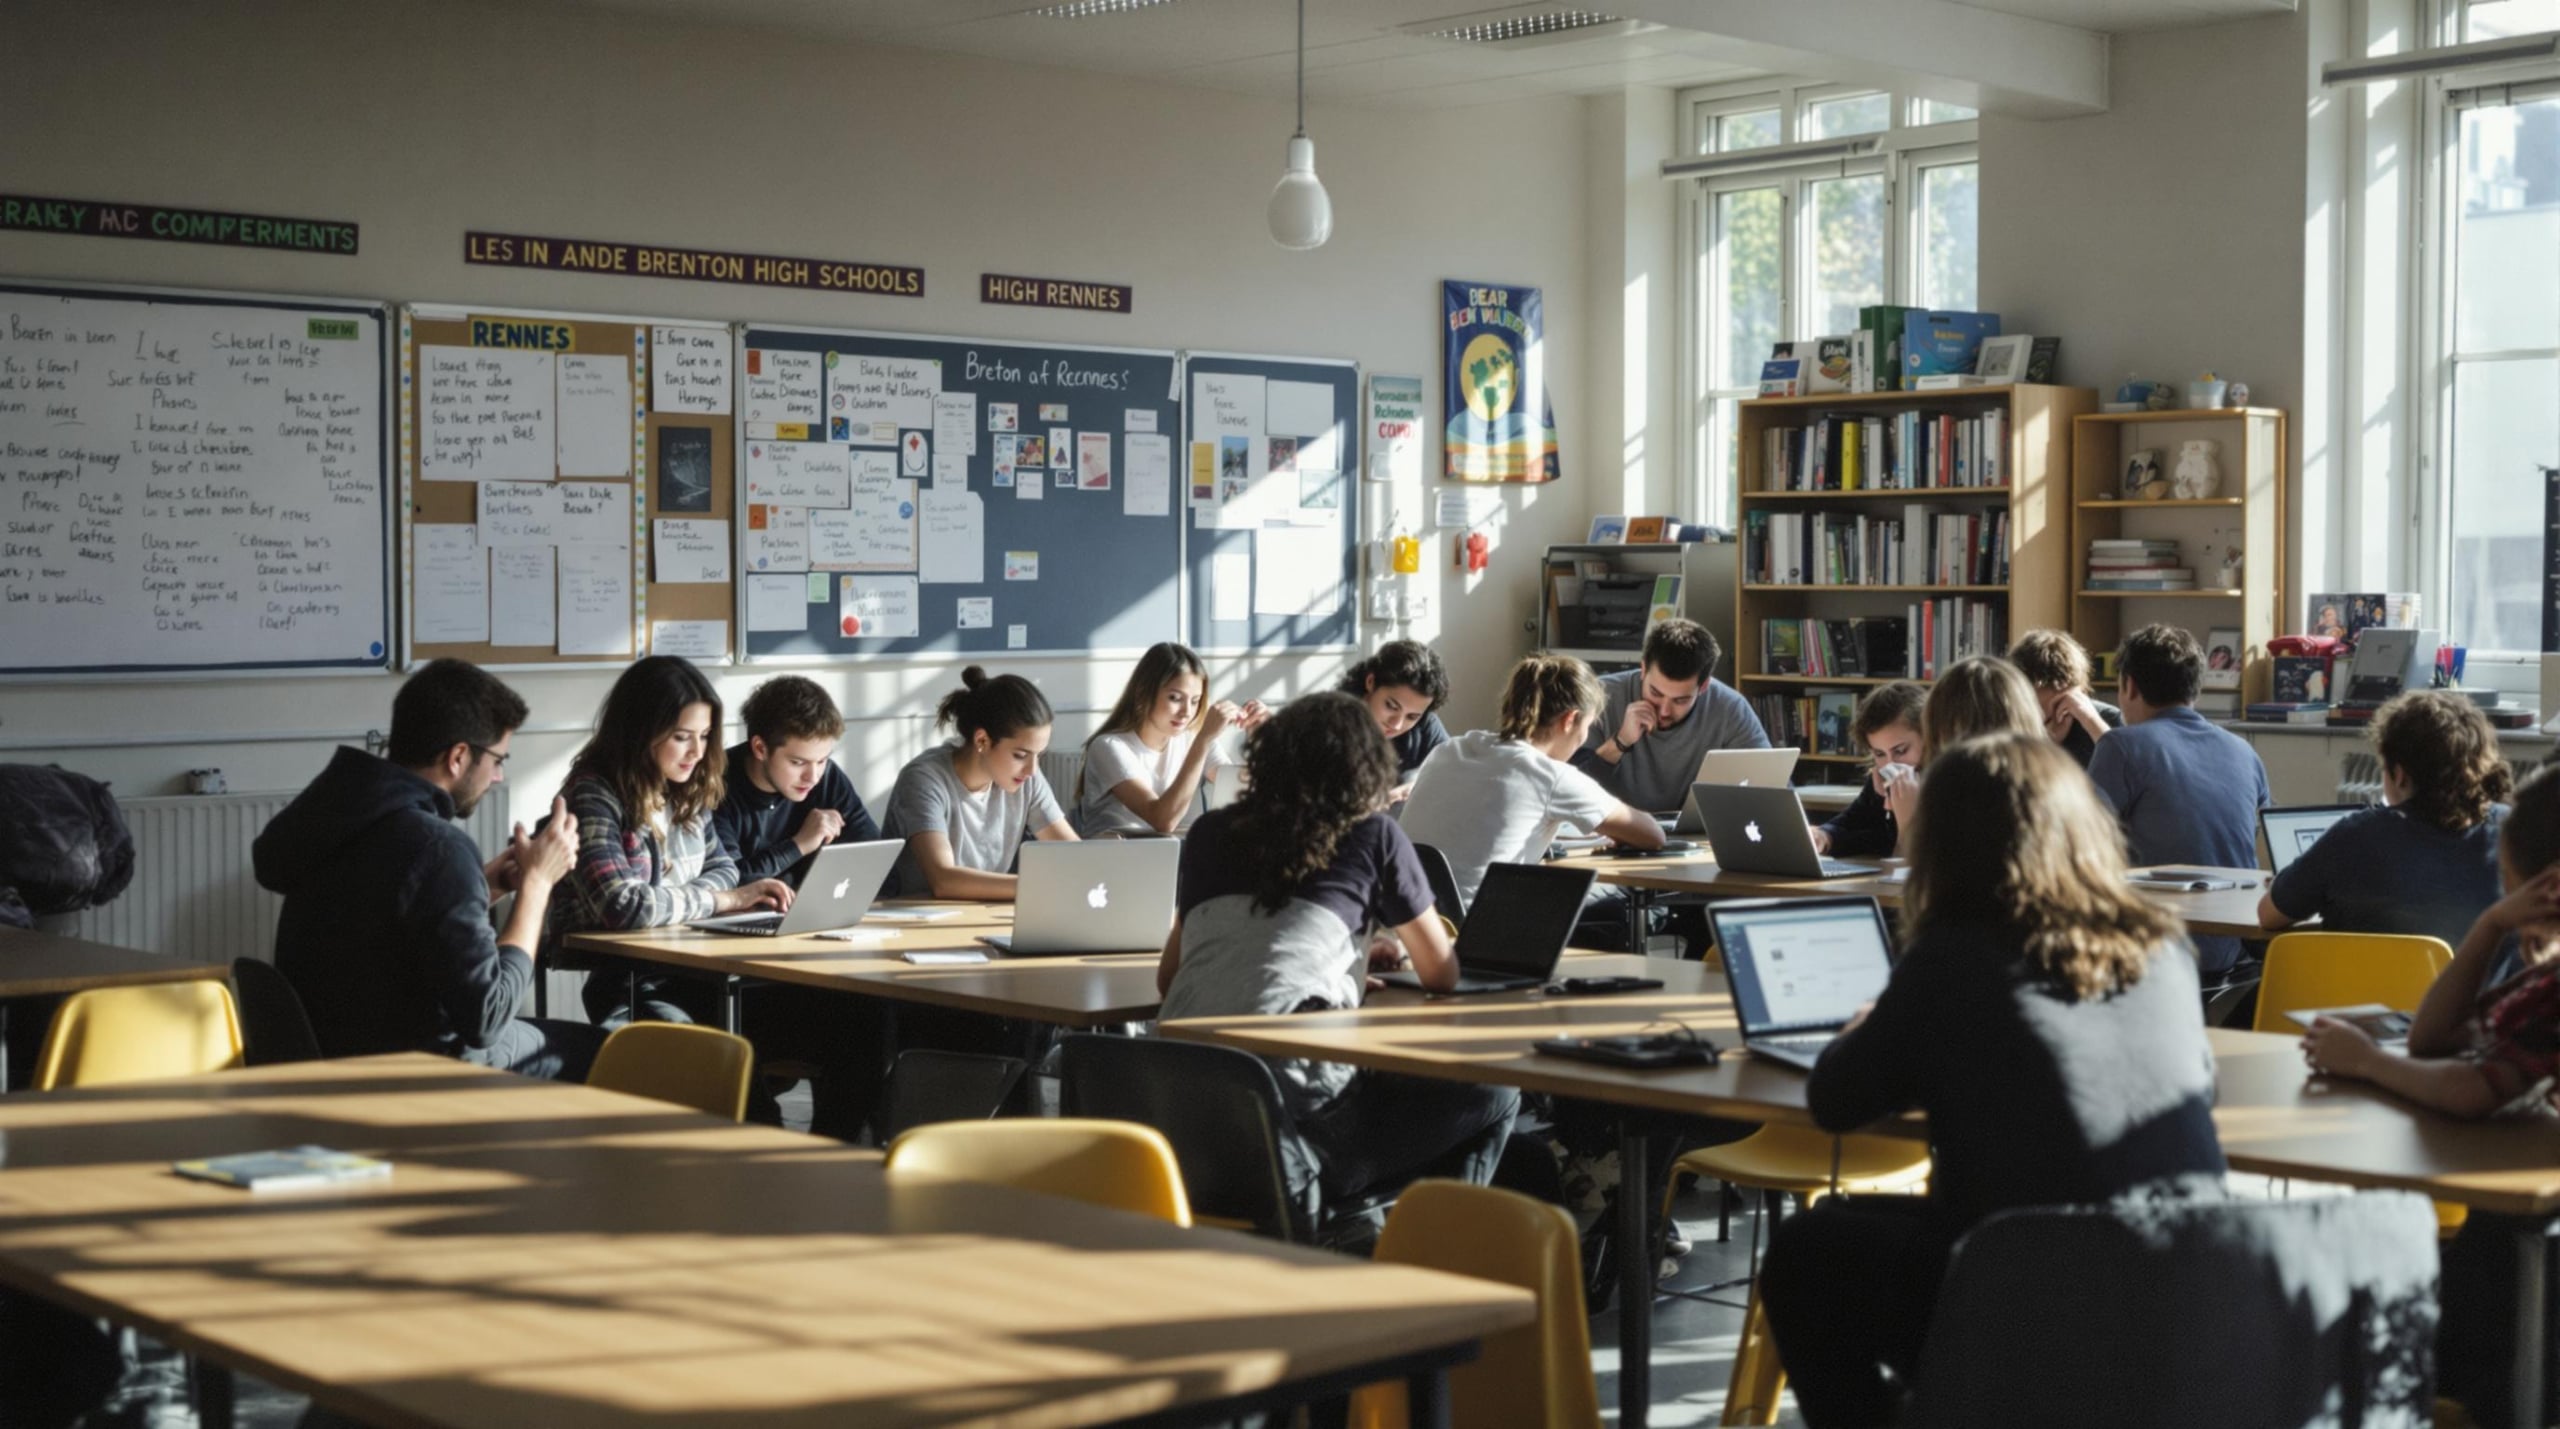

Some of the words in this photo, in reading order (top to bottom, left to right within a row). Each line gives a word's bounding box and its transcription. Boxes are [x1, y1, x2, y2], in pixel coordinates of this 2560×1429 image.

[470, 237, 513, 262] LES
[523, 240, 549, 265] IN
[561, 243, 627, 271] ANDE
[637, 249, 744, 281] BRENTON
[754, 259, 808, 285] HIGH
[819, 264, 919, 293] SCHOOLS
[989, 277, 1039, 304] HIGH
[1047, 282, 1121, 310] RENNES
[473, 320, 570, 350] RENNES
[966, 351, 1021, 382] Breton
